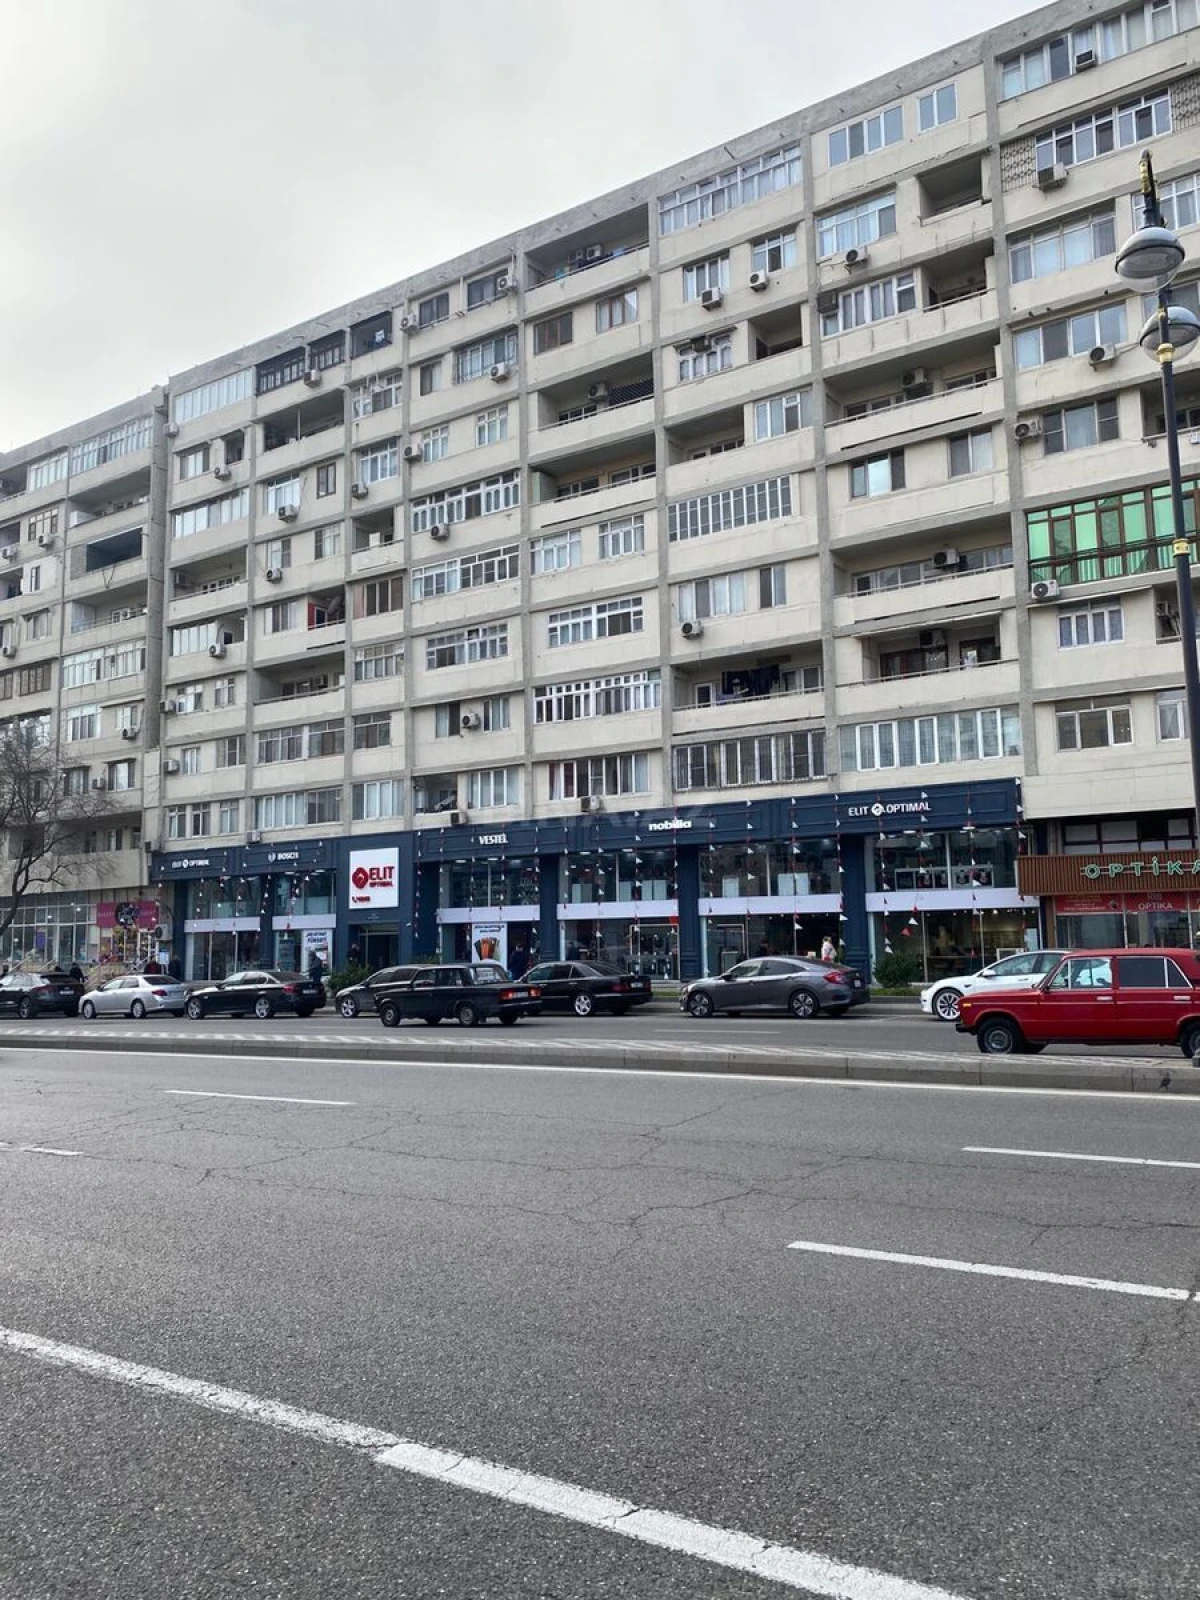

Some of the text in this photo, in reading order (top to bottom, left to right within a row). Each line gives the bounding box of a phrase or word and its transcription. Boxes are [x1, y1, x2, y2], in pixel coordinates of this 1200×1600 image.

[848, 801, 932, 817] ELIT OPTIMAL
[648, 818, 693, 831] nobilia
[479, 833, 508, 844] VESTEL
[369, 866, 395, 880] ELIT
[1138, 901, 1173, 910] OPTIKA
